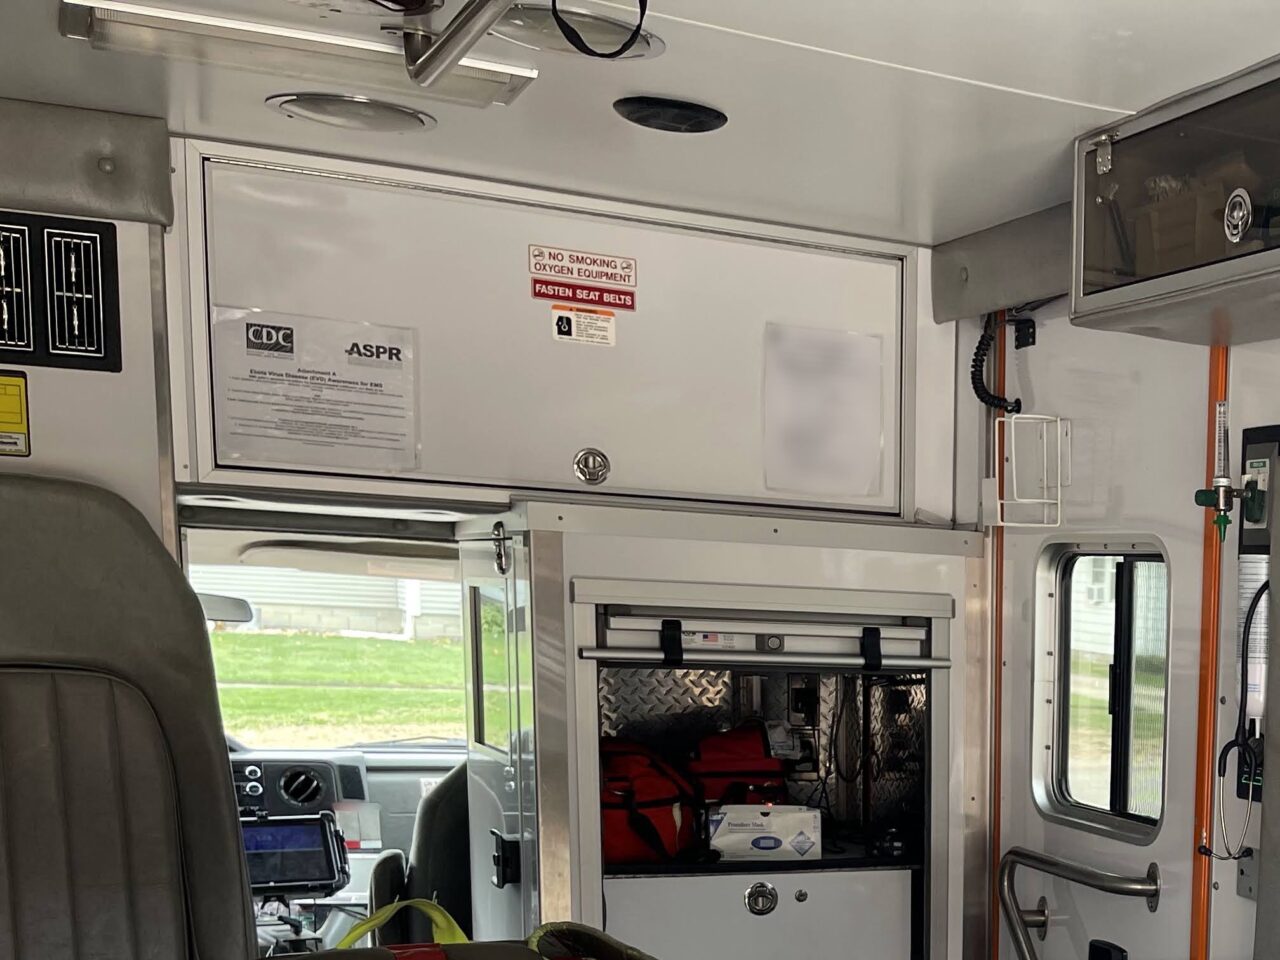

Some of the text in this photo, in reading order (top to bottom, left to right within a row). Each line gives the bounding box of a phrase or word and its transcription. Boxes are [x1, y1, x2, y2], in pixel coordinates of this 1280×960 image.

[548, 251, 617, 270] NO SMOKING
[534, 262, 632, 283] OXYGEN EQUIPMENT
[535, 283, 632, 305] FASTEN SEAT BELTS
[248, 326, 292, 346] CDC
[347, 342, 402, 361] ASPR
[268, 370, 284, 378] Virus
[285, 372, 308, 380] Disease
